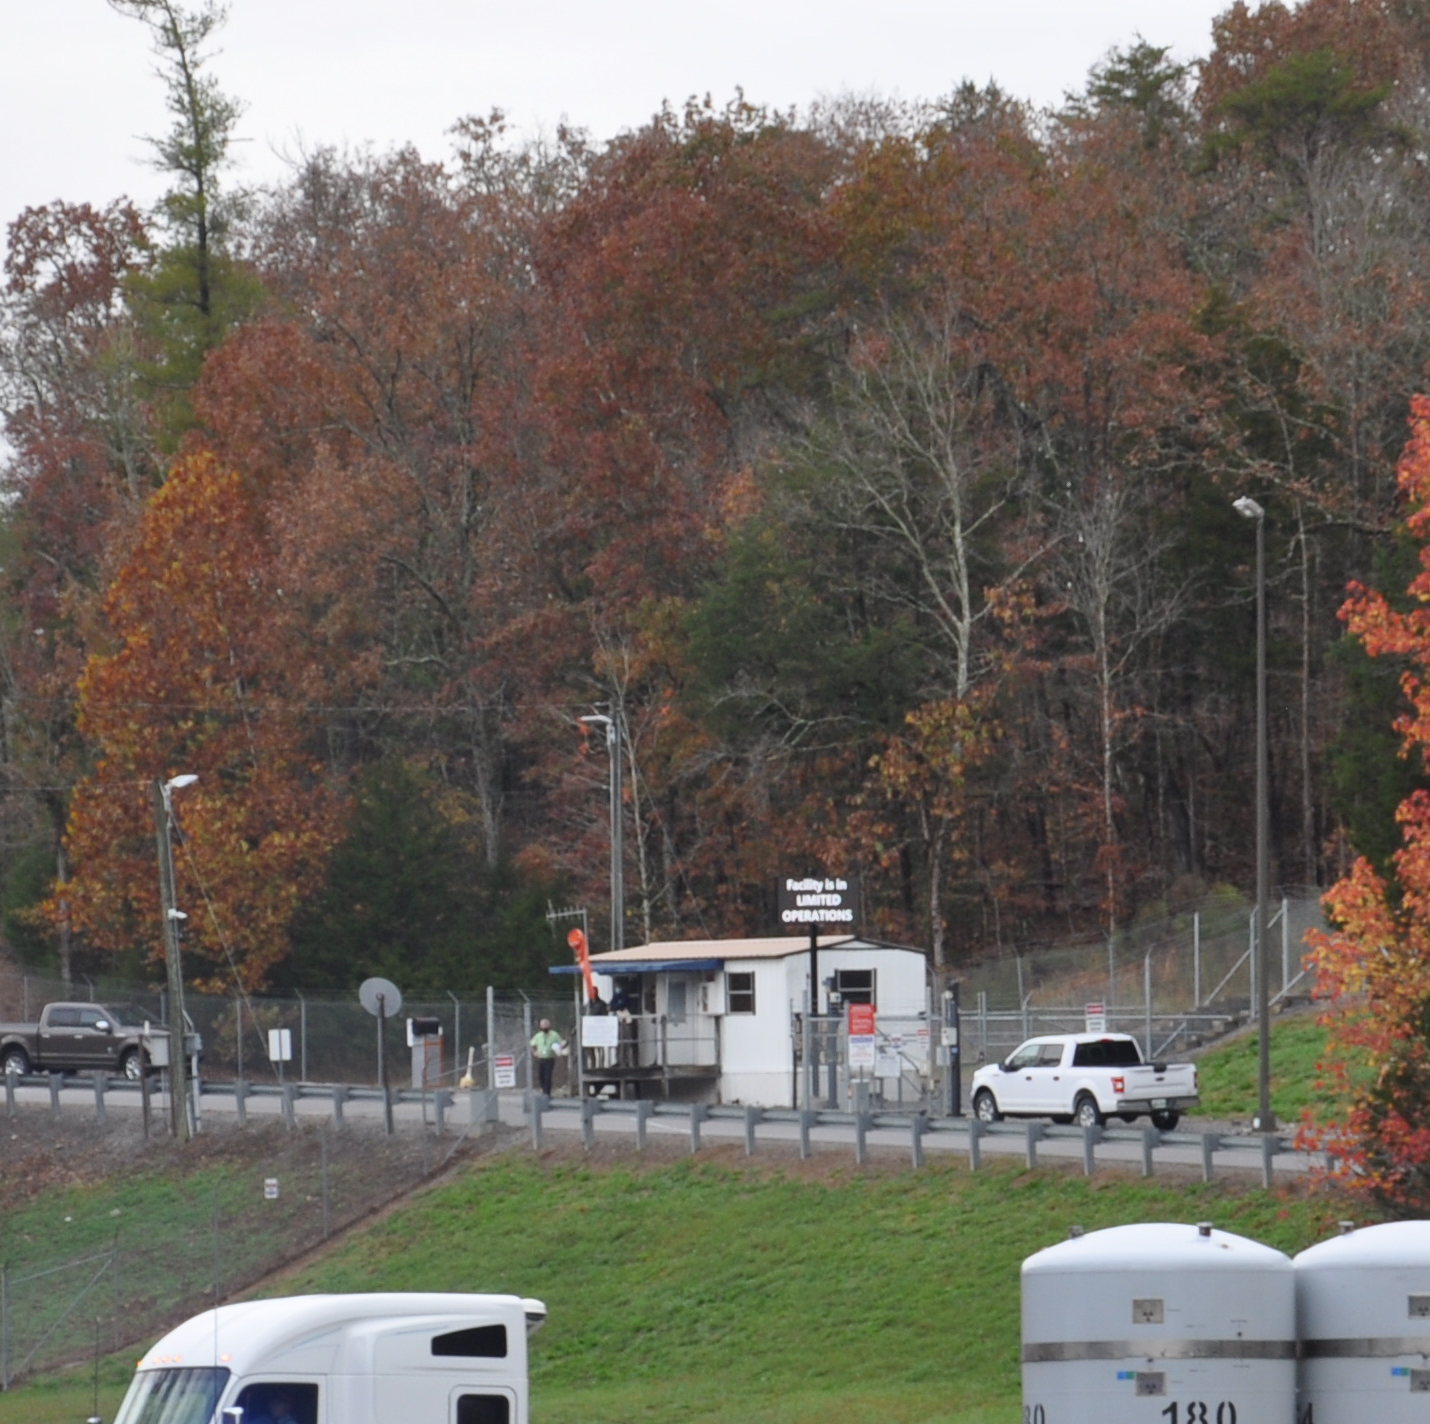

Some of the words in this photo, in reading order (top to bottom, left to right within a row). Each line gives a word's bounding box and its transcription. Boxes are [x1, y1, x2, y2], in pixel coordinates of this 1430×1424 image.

[786, 878, 823, 893] Facility
[825, 878, 834, 890] is
[836, 878, 847, 890] in
[796, 894, 842, 906] LIMITED
[782, 909, 853, 922] OPERATIONS
